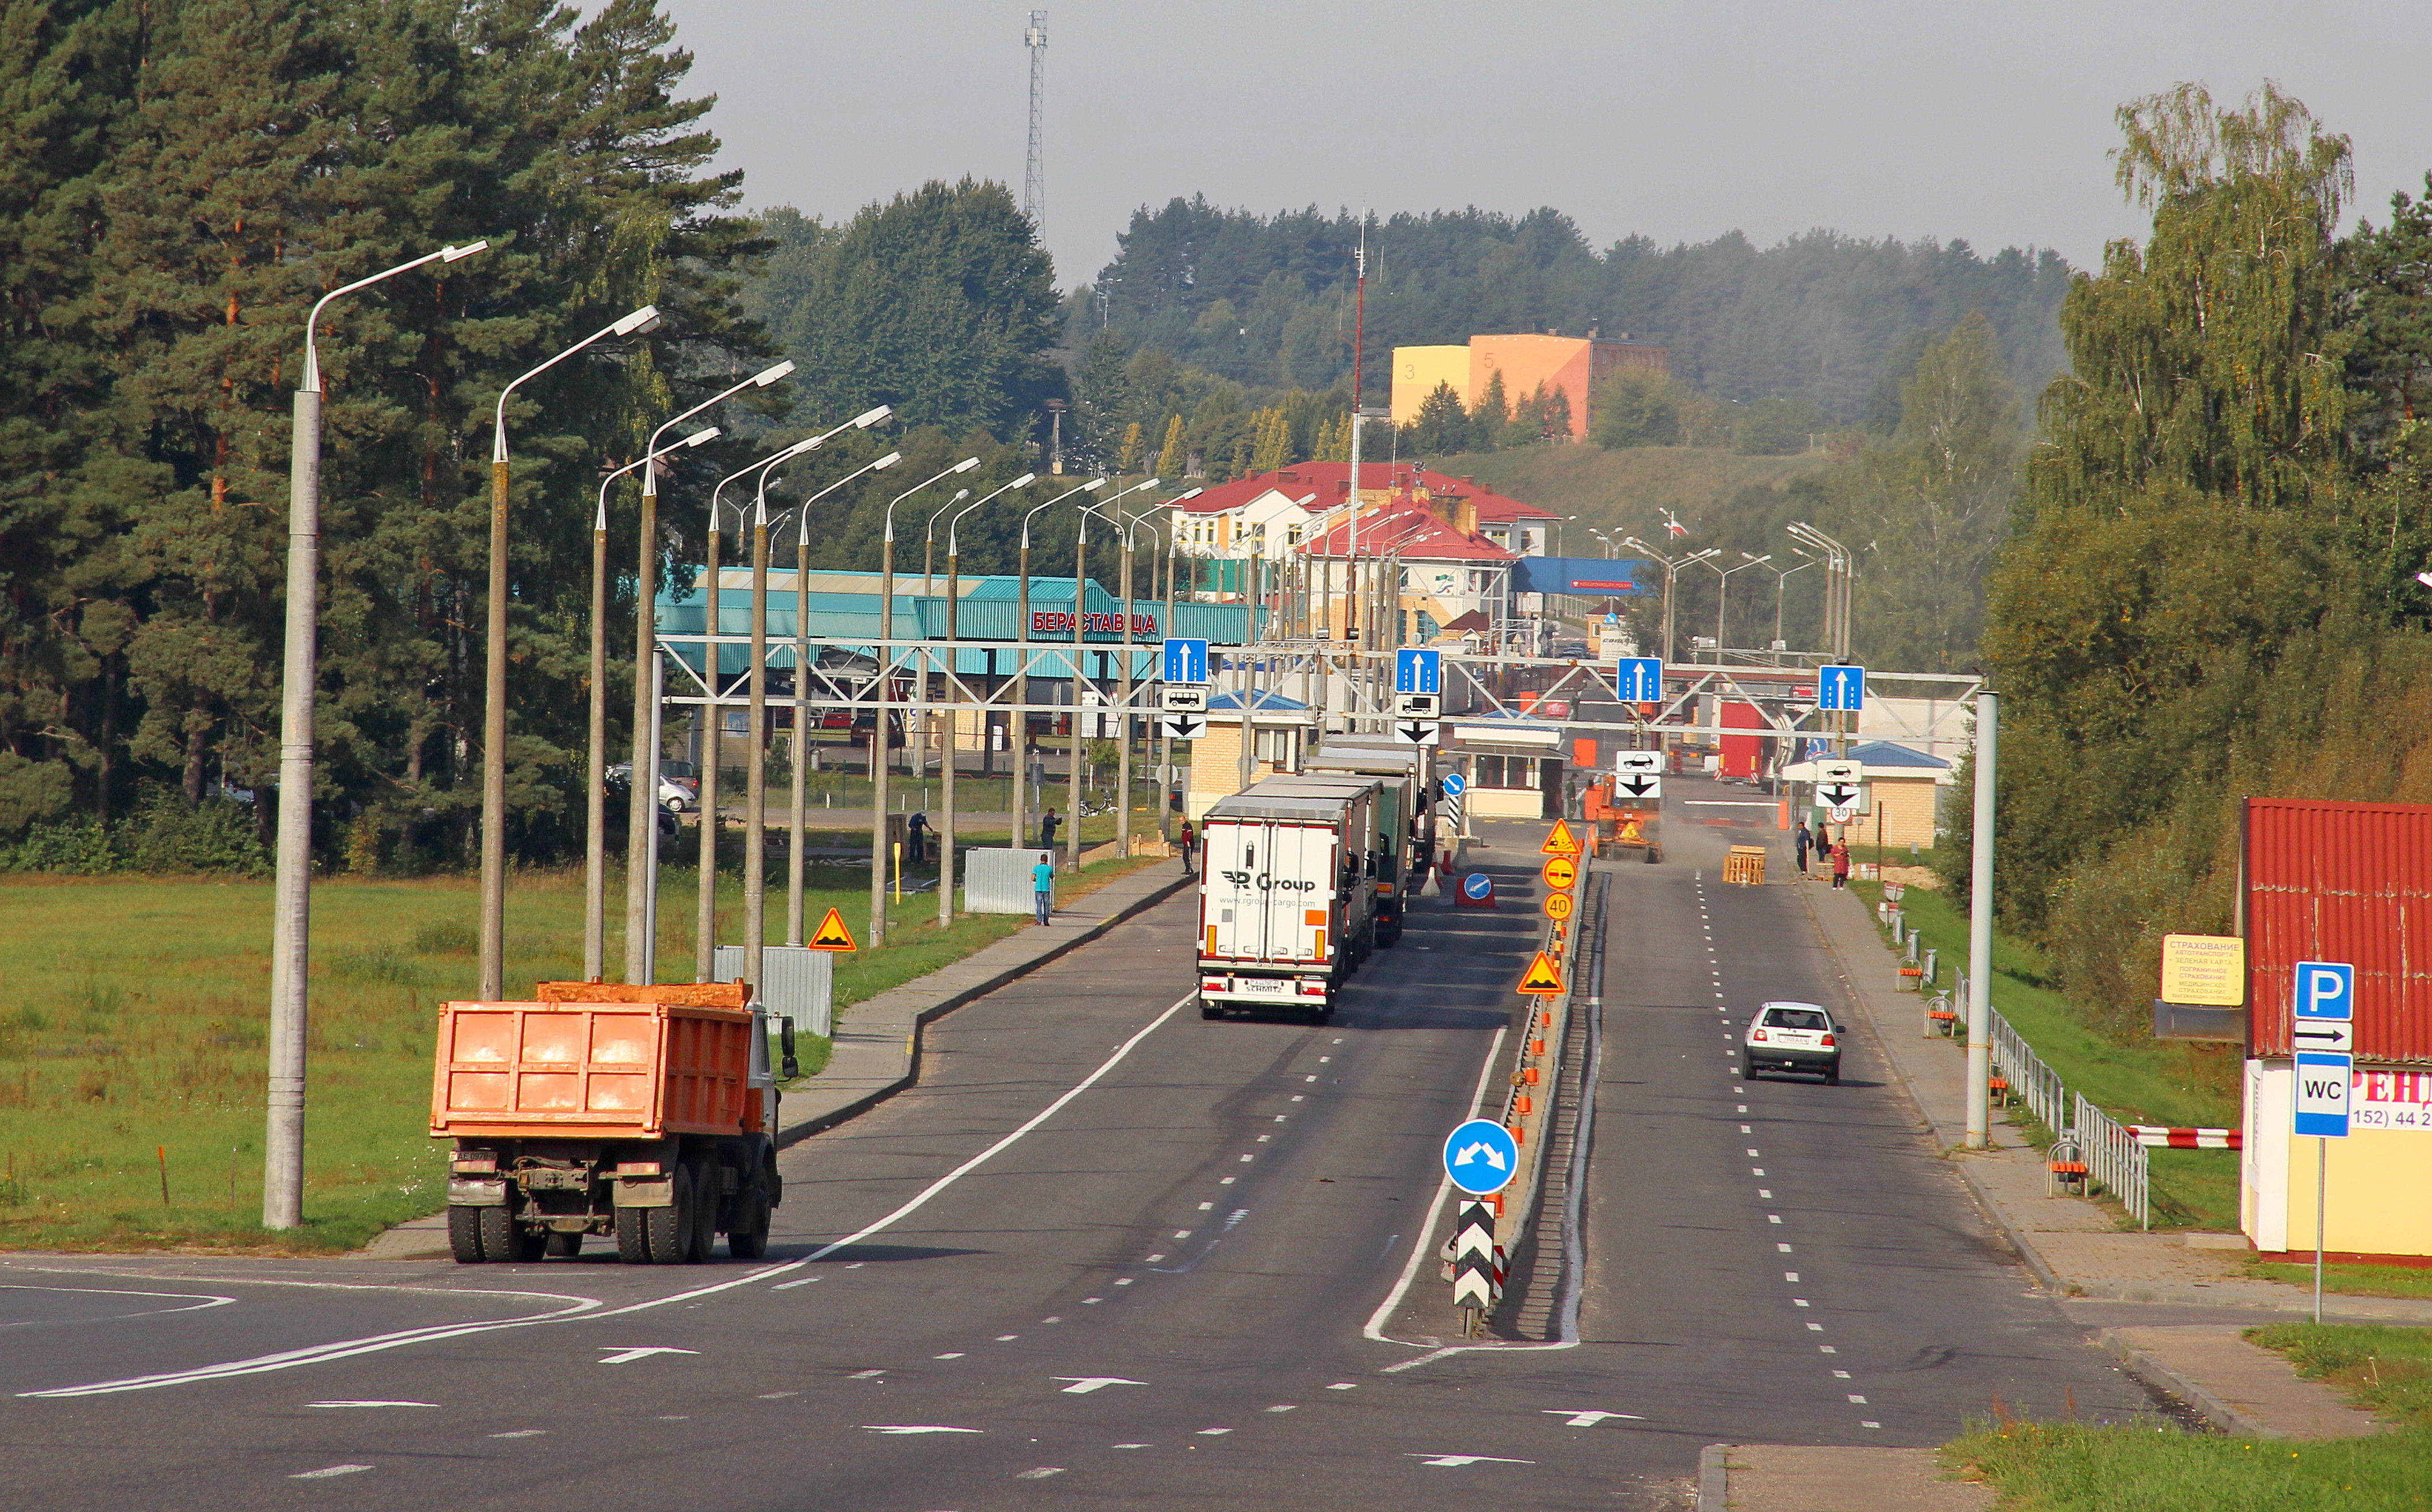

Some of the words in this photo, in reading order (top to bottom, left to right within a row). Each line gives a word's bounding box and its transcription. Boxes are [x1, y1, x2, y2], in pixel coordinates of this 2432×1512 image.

[1484, 353, 1494, 368] 5
[1405, 364, 1415, 380] 3
[1033, 612, 1156, 636] БЕРАСТАВЦА
[1835, 807, 1848, 817] 30
[1256, 872, 1316, 892] Group
[1219, 896, 1315, 908] www.rgrou-cargo.com
[1549, 899, 1567, 912] 40
[2170, 941, 2240, 951] СТРАХОВАНИЕ
[2309, 969, 2344, 1012] P
[2305, 1080, 2341, 1099] WC
[2395, 1112, 2416, 1125] 44
